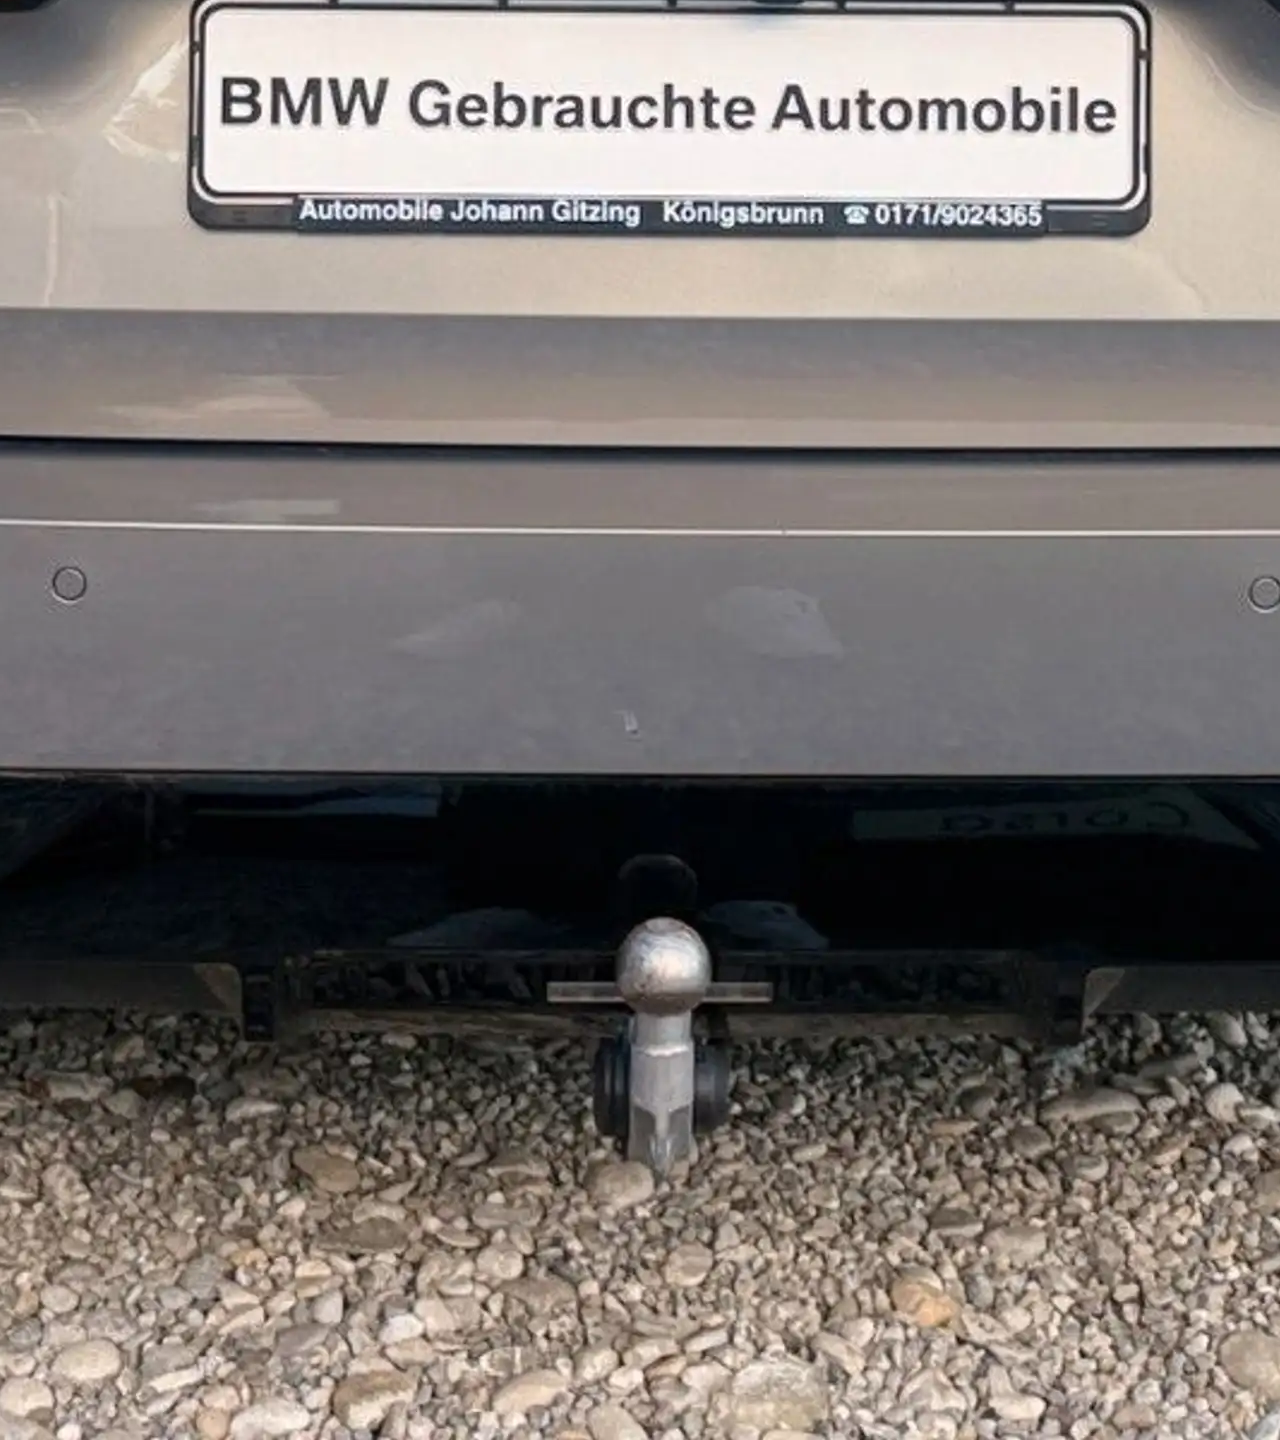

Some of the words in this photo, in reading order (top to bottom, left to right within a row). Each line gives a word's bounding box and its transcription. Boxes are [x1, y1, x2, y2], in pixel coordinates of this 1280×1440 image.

[220, 76, 389, 126] BMW
[409, 79, 756, 130] Gebrauchte
[771, 84, 1117, 134] Automobile
[298, 199, 444, 222] Automobile
[450, 200, 546, 223] Johann
[551, 200, 642, 227] Gitzing
[663, 201, 825, 228] Königsbrunn
[875, 202, 1043, 228] 0171/9024365
